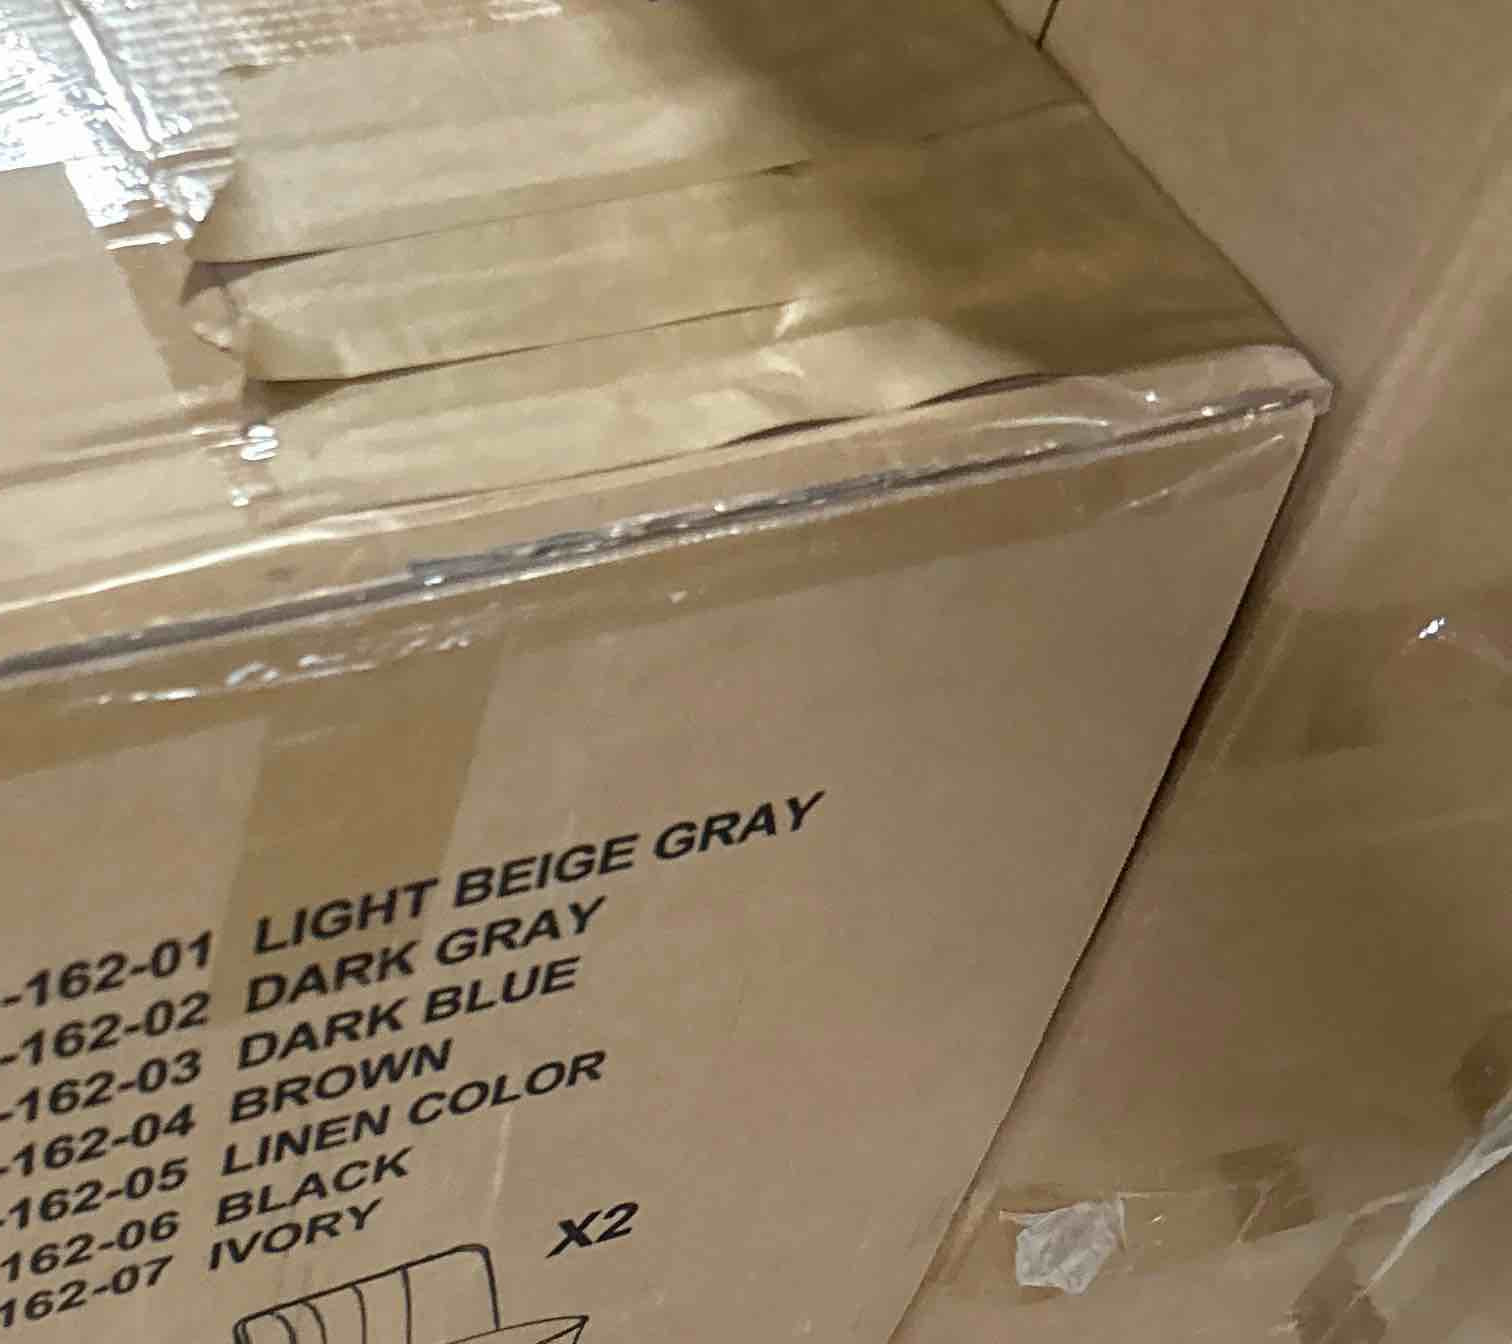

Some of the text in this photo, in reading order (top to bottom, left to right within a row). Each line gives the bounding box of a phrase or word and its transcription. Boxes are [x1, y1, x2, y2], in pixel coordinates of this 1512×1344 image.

[253, 877, 440, 955] LIGHT
[453, 833, 641, 908] BEIGE
[652, 790, 828, 861] GRAY
[244, 941, 418, 1014] DARK
[435, 895, 607, 966] GRAY
[236, 997, 409, 1071] DARK
[423, 956, 583, 1024] BLUE
[221, 1104, 391, 1176] LINEN
[408, 1050, 607, 1126] COLOR
[229, 1038, 454, 1123] BROWN
[208, 1198, 384, 1272] IVORY
[215, 1146, 415, 1226] BLACK
[545, 1201, 640, 1258] X2
